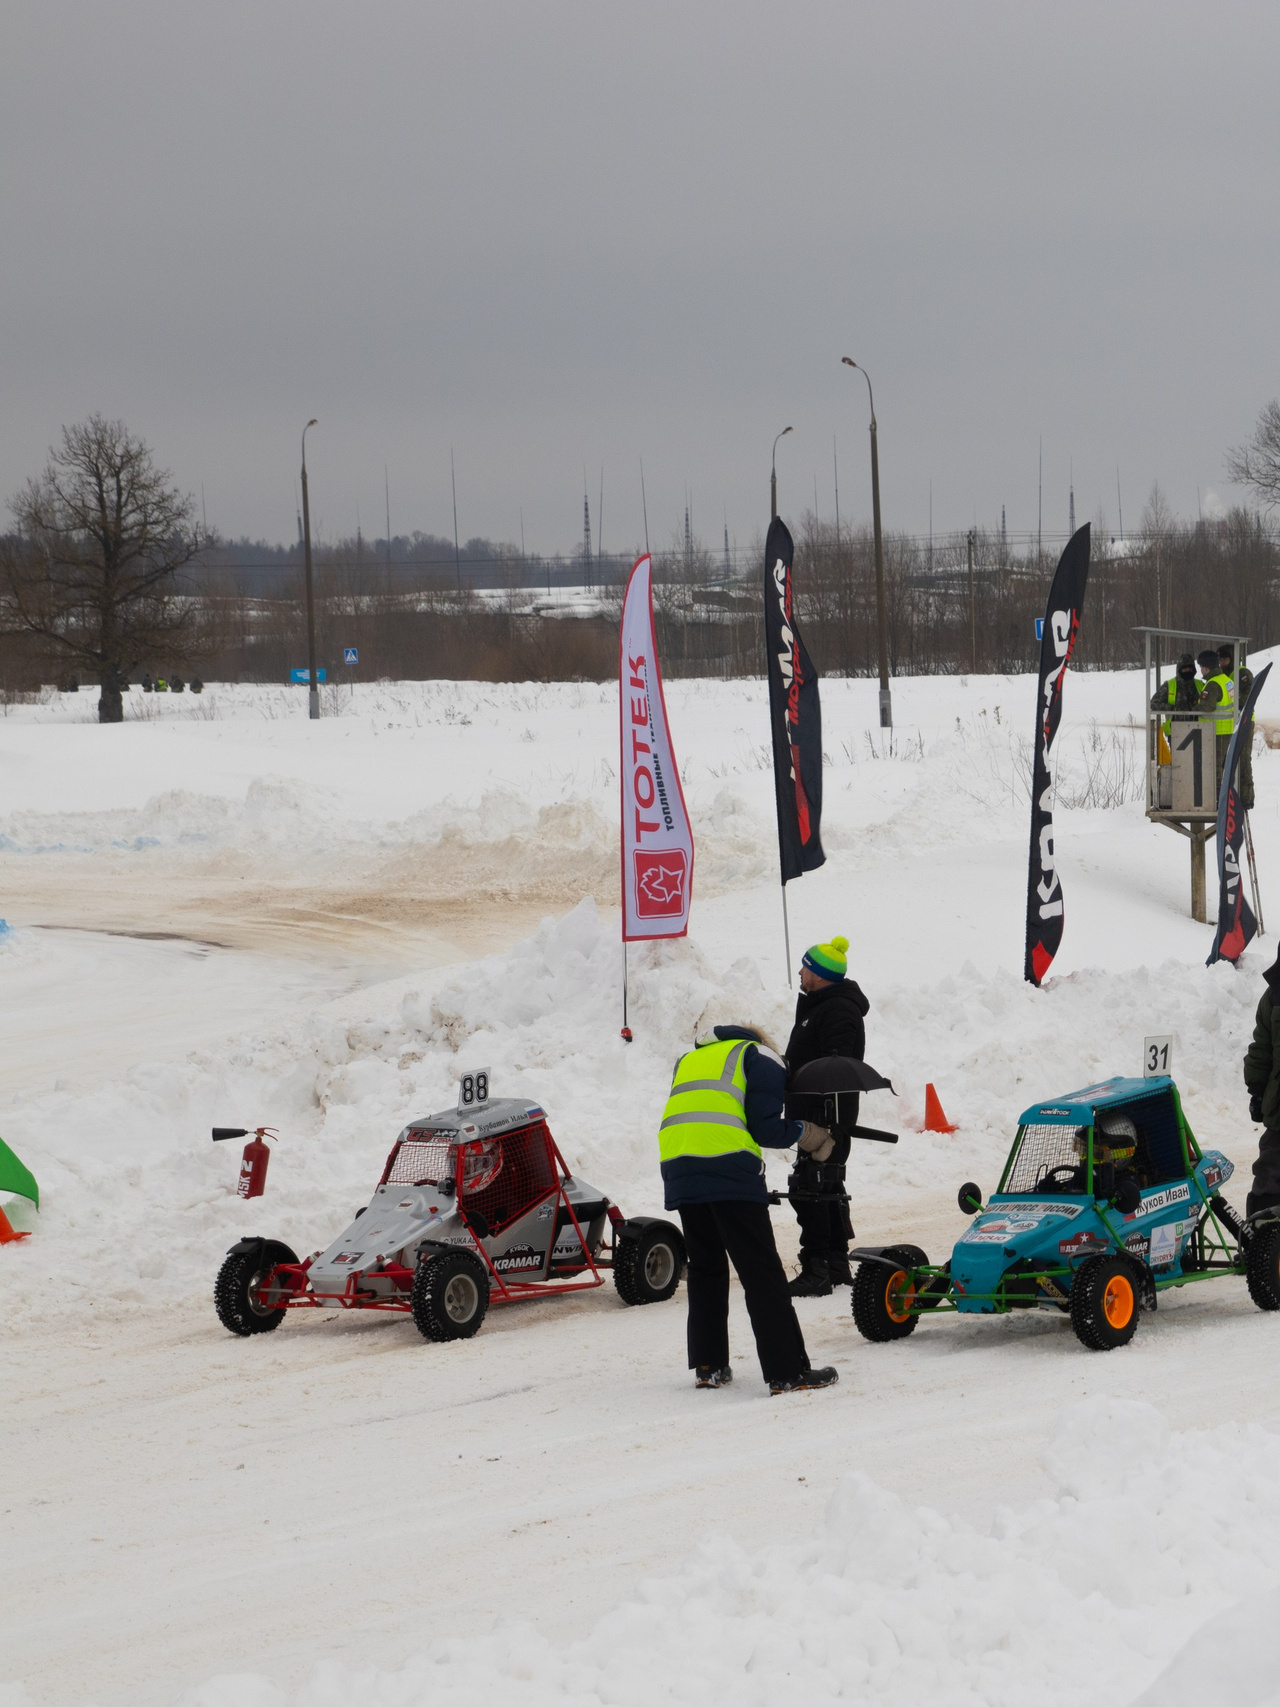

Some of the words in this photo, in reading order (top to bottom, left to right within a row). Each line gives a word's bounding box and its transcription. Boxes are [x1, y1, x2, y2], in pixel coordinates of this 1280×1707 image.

[1177, 729, 1202, 807] 1
[653, 753, 675, 831] ТОПЛИВНЫЕ
[1147, 1043, 1169, 1071] 31
[461, 1071, 489, 1105] 88
[479, 1117, 510, 1133] Курбатов
[511, 1113, 529, 1123] Илья
[407, 1128, 436, 1141] GS
[241, 1159, 254, 1172] 2
[985, 1204, 1040, 1213] АВТОКРОСС
[1036, 1204, 1081, 1217] РОССИИ
[1137, 1195, 1164, 1218] Жуков
[1165, 1186, 1189, 1203] Иван
[509, 1243, 530, 1254] КУБОК
[493, 1255, 541, 1270] KRAMAR
